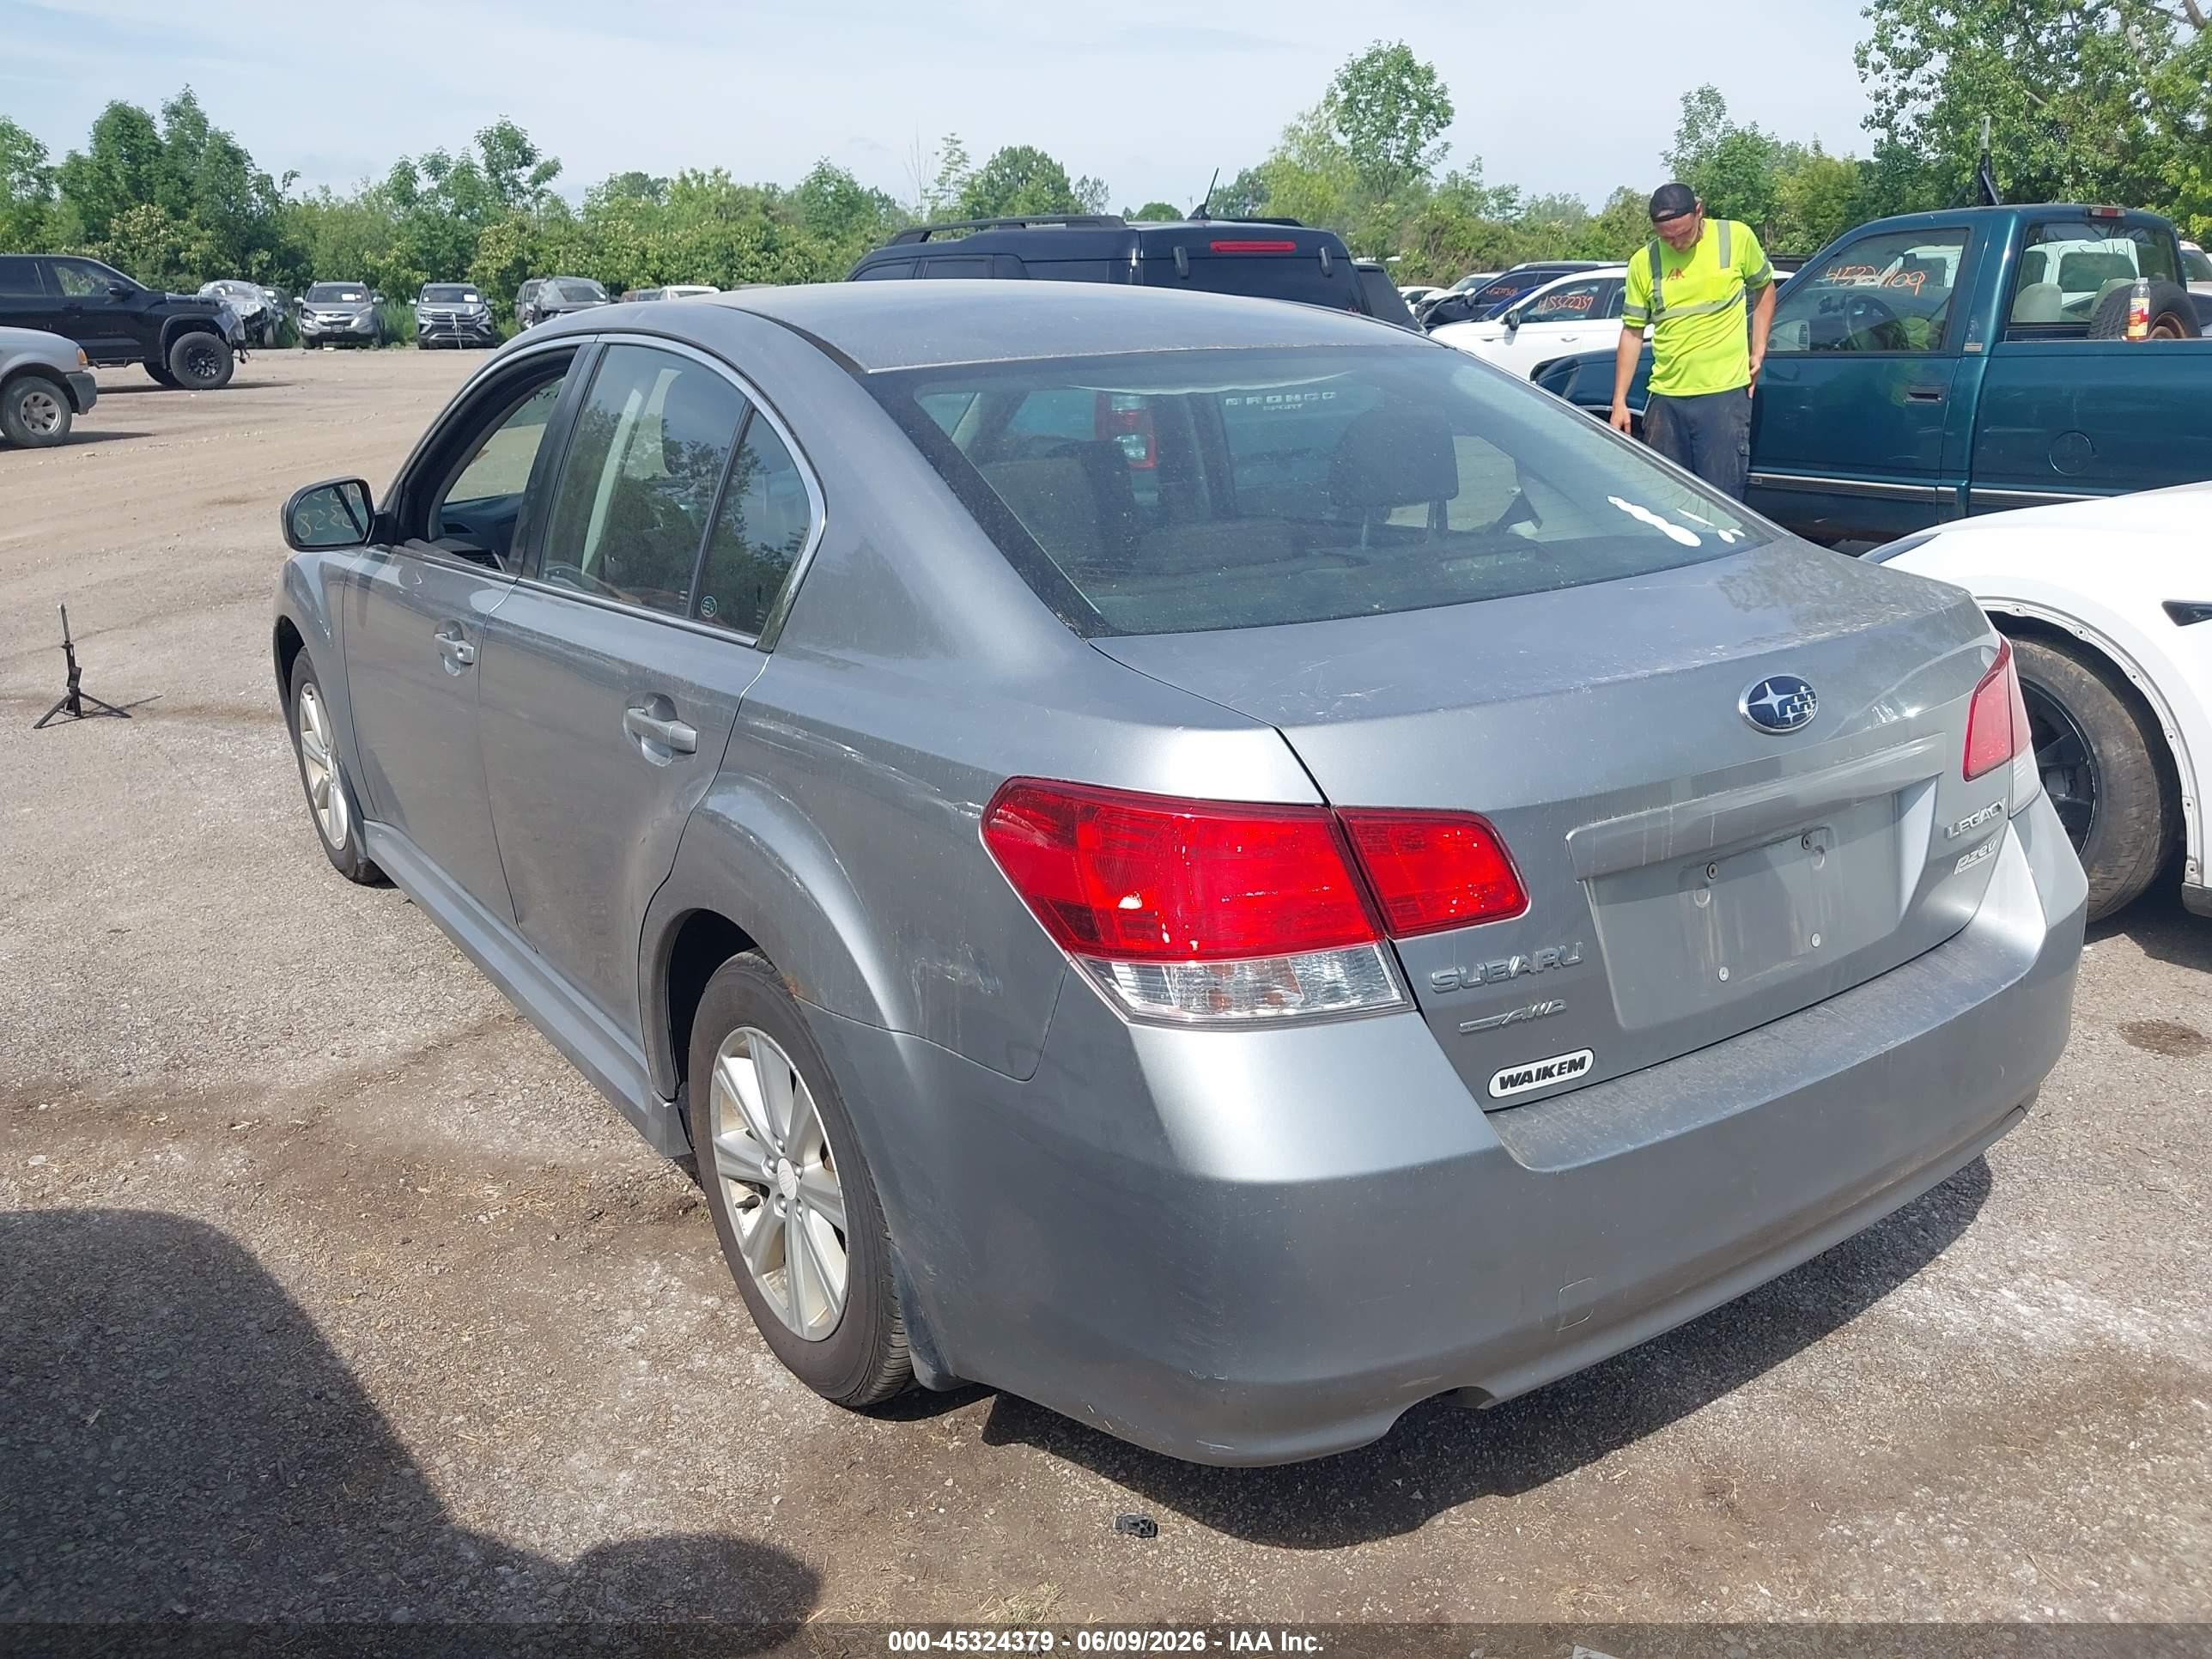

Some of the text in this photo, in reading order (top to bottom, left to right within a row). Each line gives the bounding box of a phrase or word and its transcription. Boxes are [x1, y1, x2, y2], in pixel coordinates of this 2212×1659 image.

[1224, 392, 1336, 406] BRONCO
[1262, 403, 1304, 411] SPORT
[1943, 797, 2006, 839] LEGACY
[1431, 941, 1583, 994] SUBARU
[1501, 999, 1568, 1025] AWD
[1498, 1055, 1587, 1091] WAIKEM
